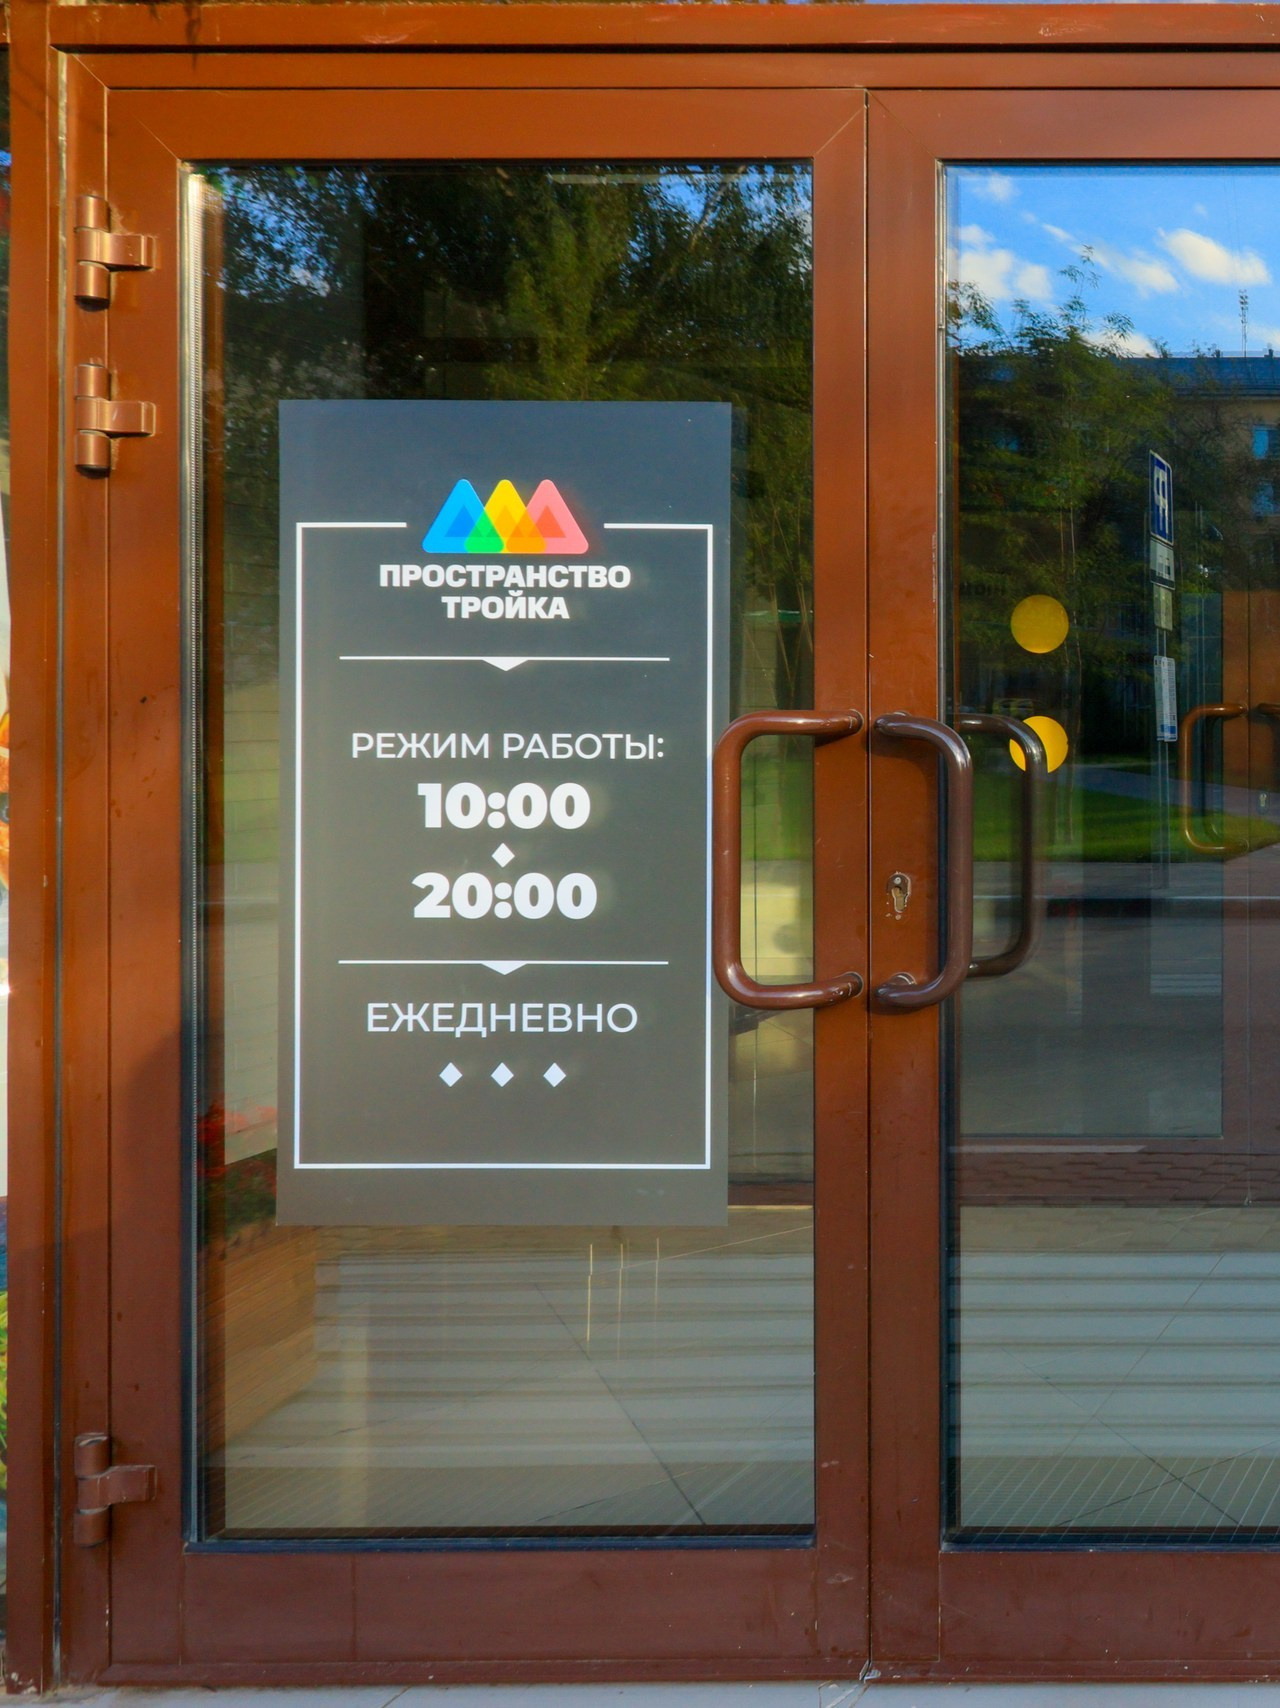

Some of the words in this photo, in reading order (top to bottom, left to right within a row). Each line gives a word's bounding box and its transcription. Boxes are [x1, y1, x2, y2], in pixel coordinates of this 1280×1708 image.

[379, 565, 631, 589] ПРОСТРАНСТВО
[441, 589, 569, 620] ТРОЙКА
[353, 733, 488, 758] РЕЖИМ
[504, 734, 663, 759] РАБОТЫ:
[418, 783, 590, 829] 10:00
[412, 872, 597, 919] 20:00
[368, 1003, 637, 1037] ЕЖЕДНЕВНО
